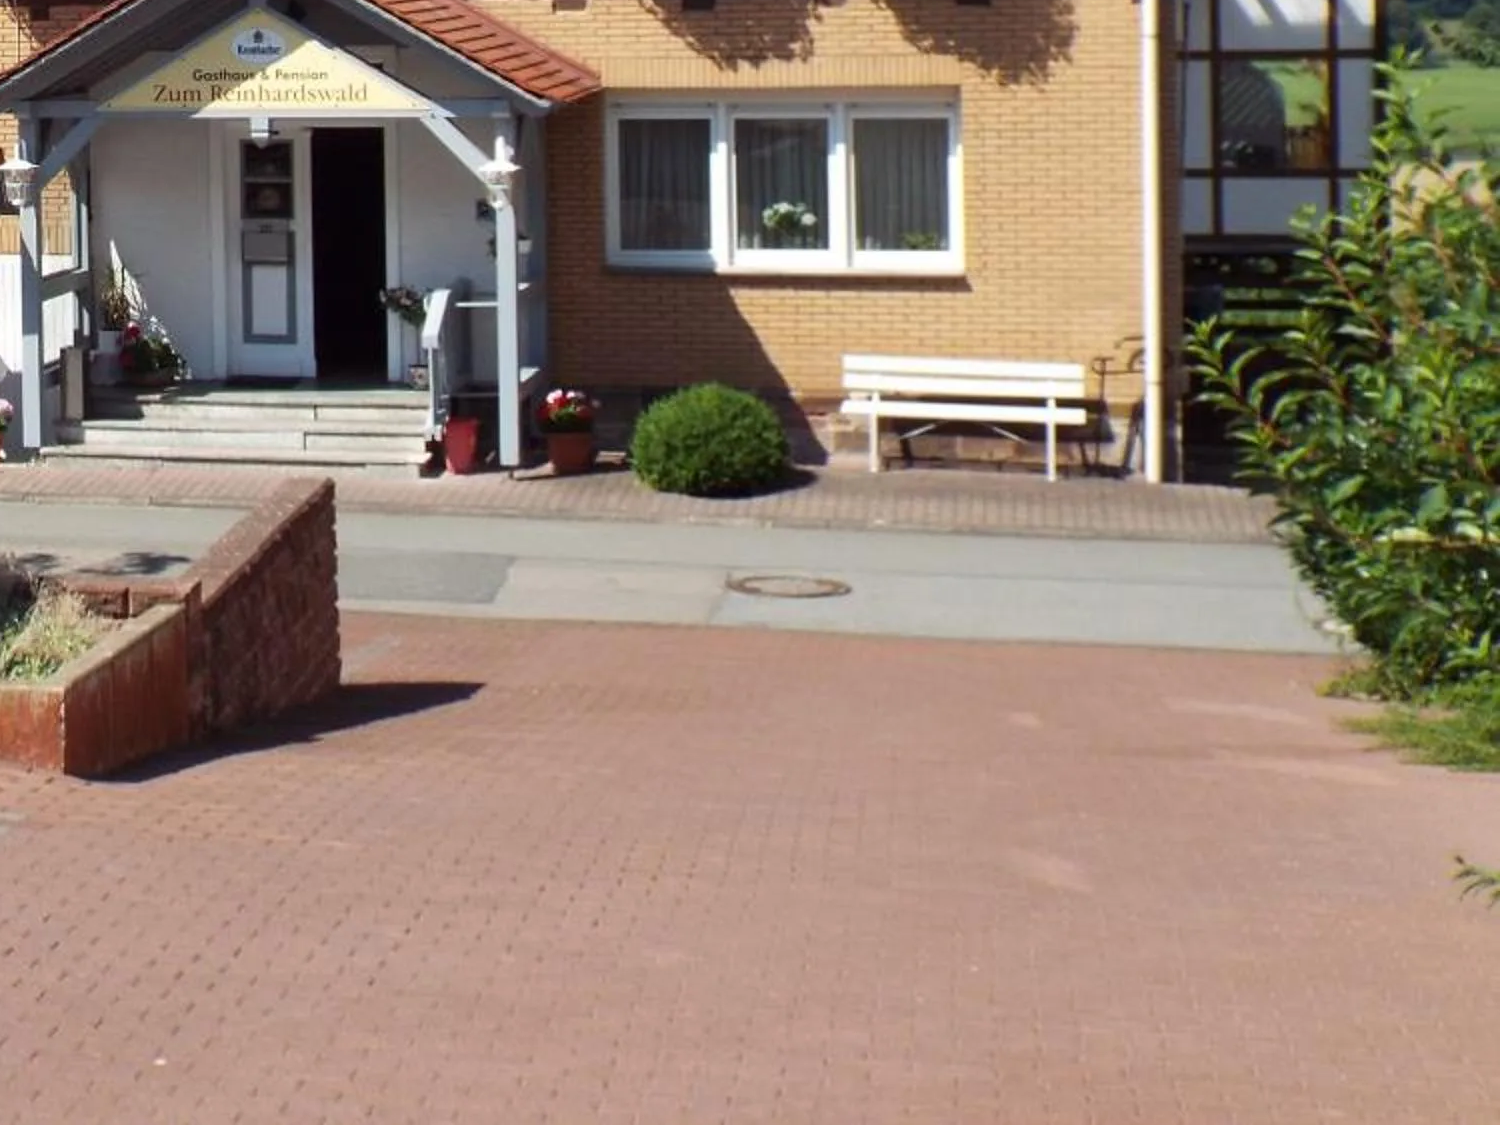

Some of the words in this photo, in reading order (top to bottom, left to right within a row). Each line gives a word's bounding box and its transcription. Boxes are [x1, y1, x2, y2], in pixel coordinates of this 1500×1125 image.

[275, 67, 328, 81] Pension
[153, 84, 202, 102] Zum
[211, 83, 368, 102] Reinhardswald
